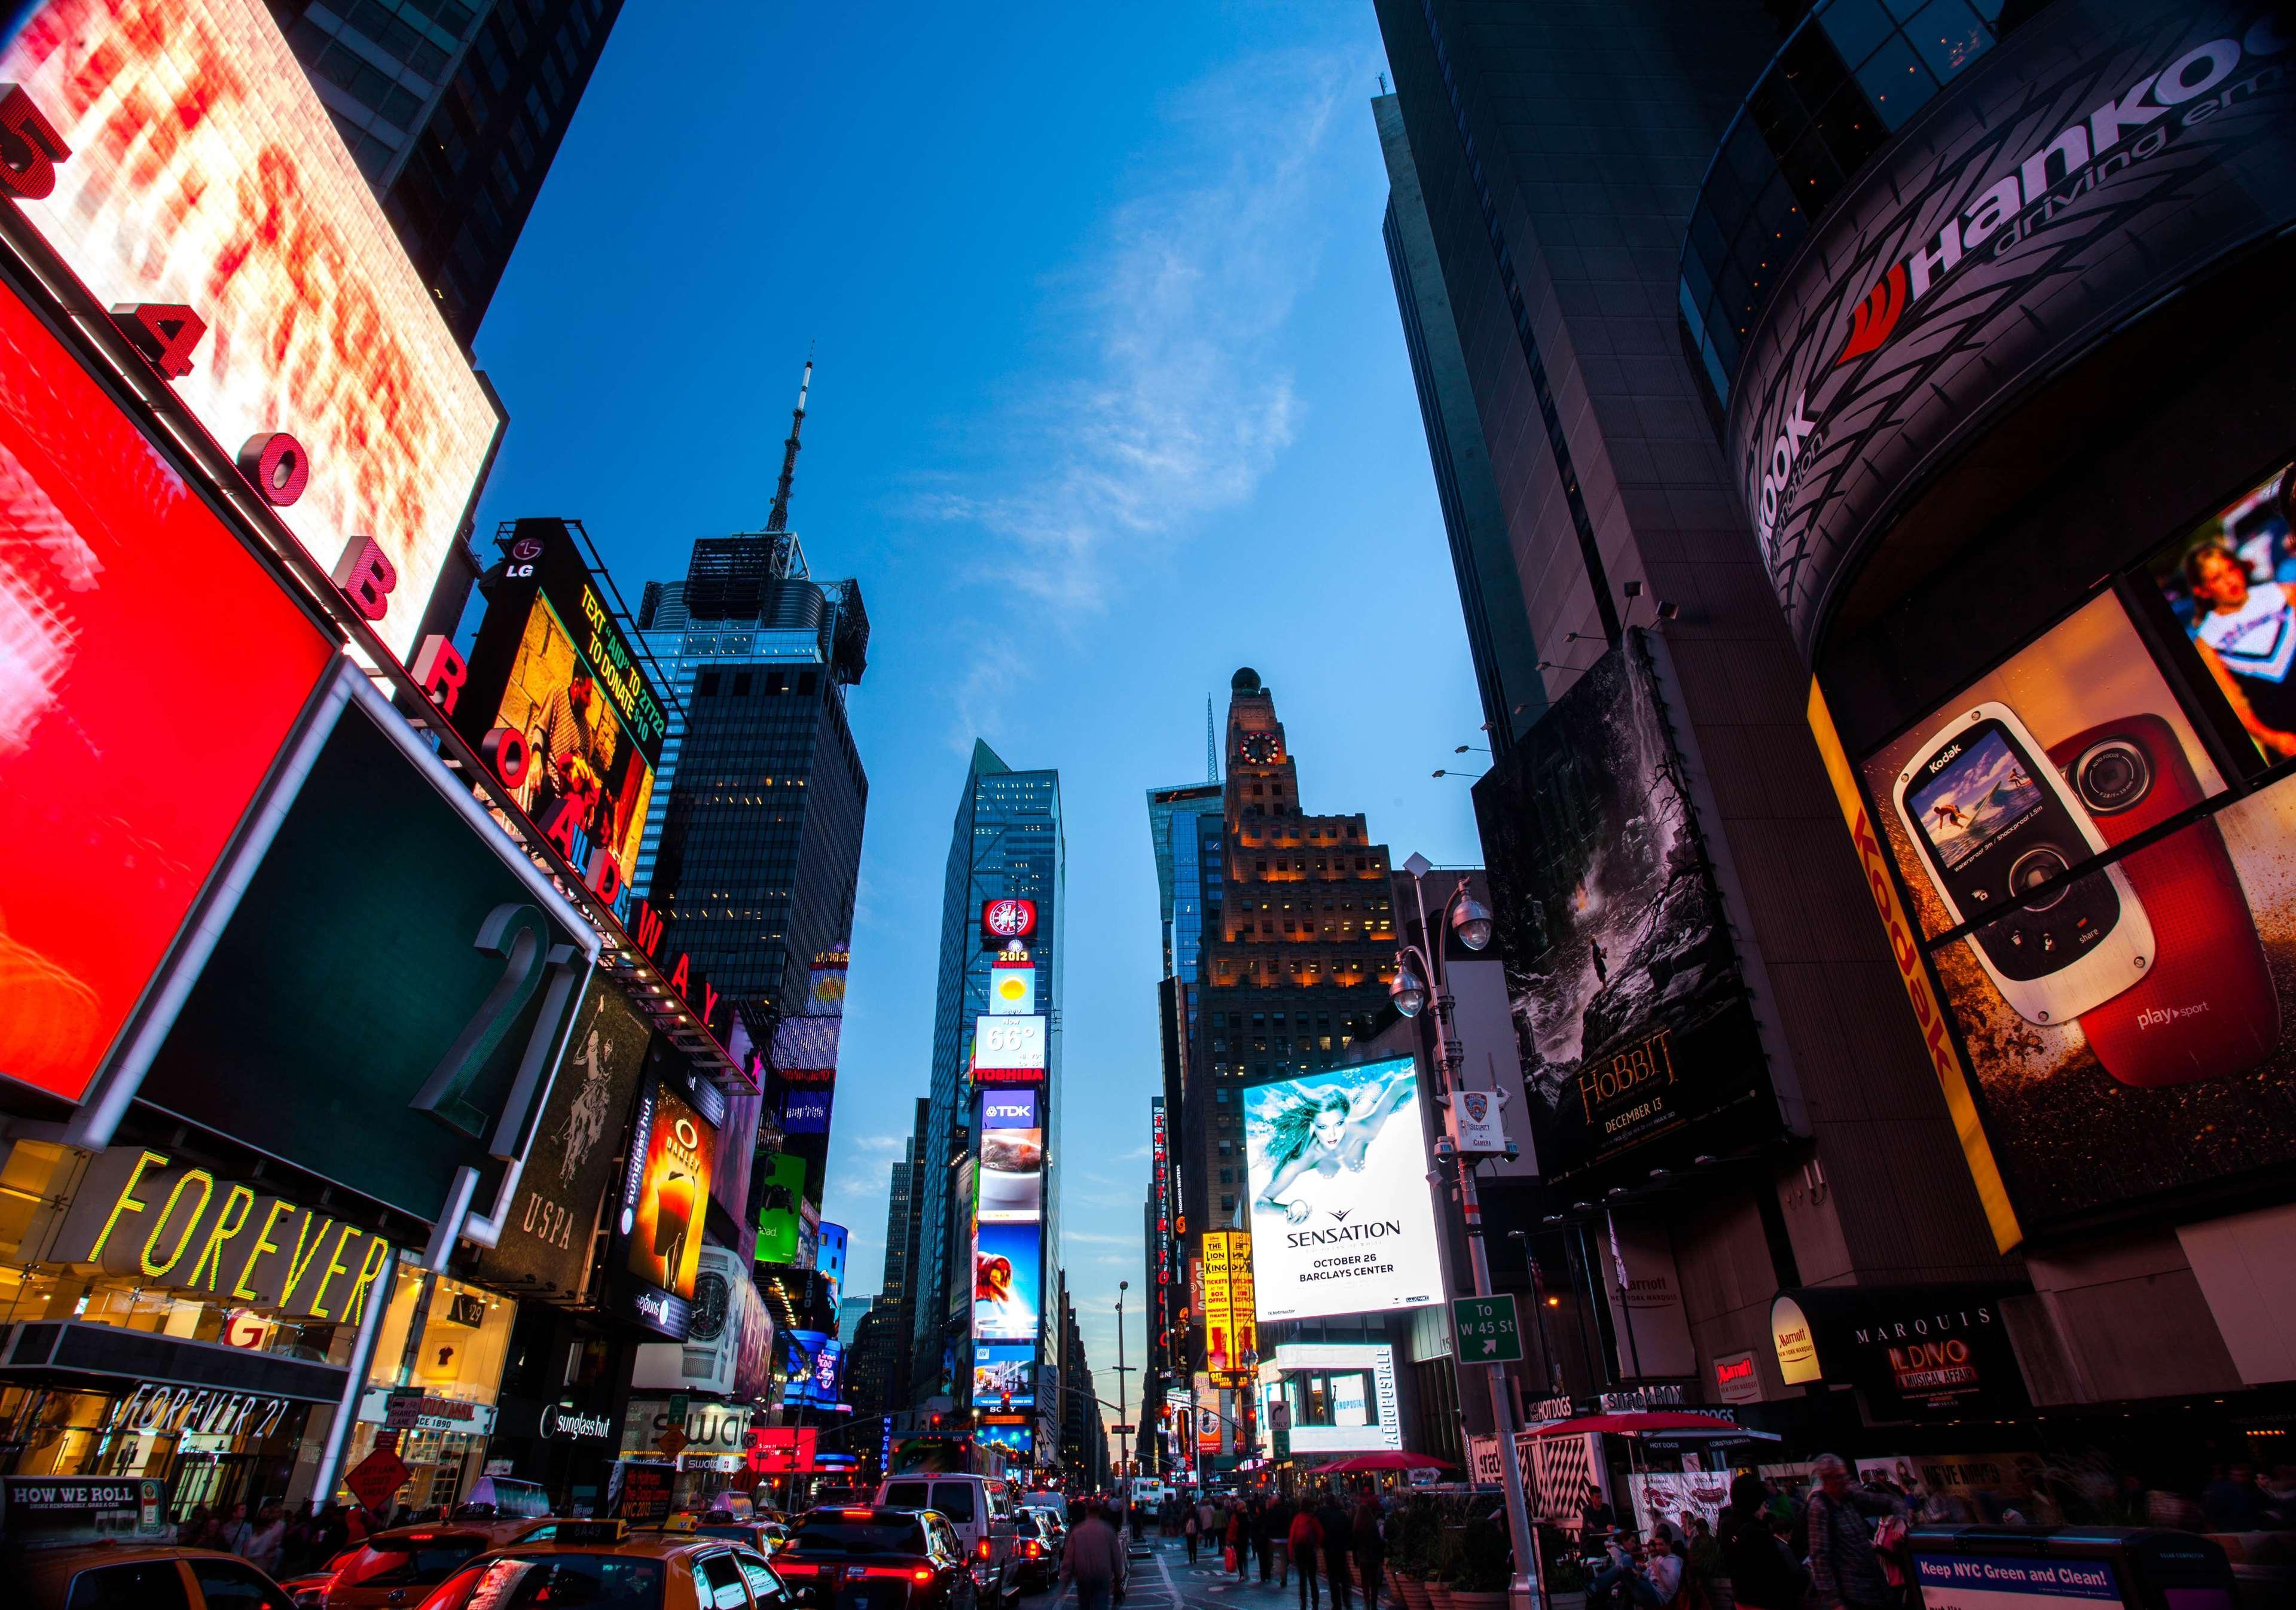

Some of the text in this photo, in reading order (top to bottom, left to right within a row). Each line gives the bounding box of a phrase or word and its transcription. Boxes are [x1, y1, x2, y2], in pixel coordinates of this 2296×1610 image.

[1993, 123, 2168, 258] driving
[506, 565, 534, 578] LG
[582, 584, 606, 634] TEXT
[629, 666, 640, 697] TO
[638, 689, 665, 739] 27722
[589, 630, 649, 742] TO DONATE $10
[1928, 742, 1962, 774] Kodak
[2092, 757, 2103, 769] AUTO
[1953, 847, 1984, 873] Waterproof
[1984, 841, 1993, 850] 3m
[1996, 815, 2031, 842] Shockproof
[2029, 805, 2044, 818] 1.5m
[1852, 806, 1954, 1087] Kodak
[2079, 928, 2100, 944] share
[999, 951, 1028, 962] 2013
[2136, 1001, 2210, 1030] play sport
[975, 1068, 1044, 1081] TOSHIBA
[996, 1105, 1031, 1117] TDK
[1605, 1103, 1651, 1134] DECEMBER
[1653, 1096, 1663, 1112] 13
[627, 1099, 654, 1205] sunglass hut
[667, 1136, 700, 1172] OAKLEY
[523, 1192, 573, 1251] USPA
[87, 1149, 391, 1327] FOREVER
[1287, 1220, 1401, 1248] SENSATION
[1206, 1251, 1225, 1262] LION
[1314, 1253, 1377, 1269] OCTOBER 26
[1205, 1262, 1228, 1274] KING
[1299, 1264, 1394, 1282] BARCLAYS CENTER
[1615, 1277, 1667, 1293] arriott
[1476, 1304, 1493, 1317] To
[1460, 1319, 1514, 1336] W 45 St
[1855, 1307, 1990, 1344] MARQUIS
[1778, 1328, 1806, 1349] Marriott
[1796, 1344, 1814, 1354] MARQUIS
[1907, 1339, 1967, 1370] DIVO
[1717, 1358, 1754, 1386] Marriott
[1898, 1367, 1974, 1388] A MUSICAL AFFAIR
[1740, 1380, 1758, 1391] MARQUIS
[124, 1383, 291, 1438] FOREVER 21
[1538, 1395, 1573, 1420] HOT DOGS
[432, 1419, 452, 1429] 1890
[557, 1411, 610, 1440] sunglass hut
[13, 1487, 135, 1503] HOW WE ROLL
[624, 1487, 637, 1501] The
[621, 1502, 637, 1518] NYC
[636, 1501, 651, 1517] 2013
[1920, 1560, 2108, 1587] Keep NYC Green and Clean!
